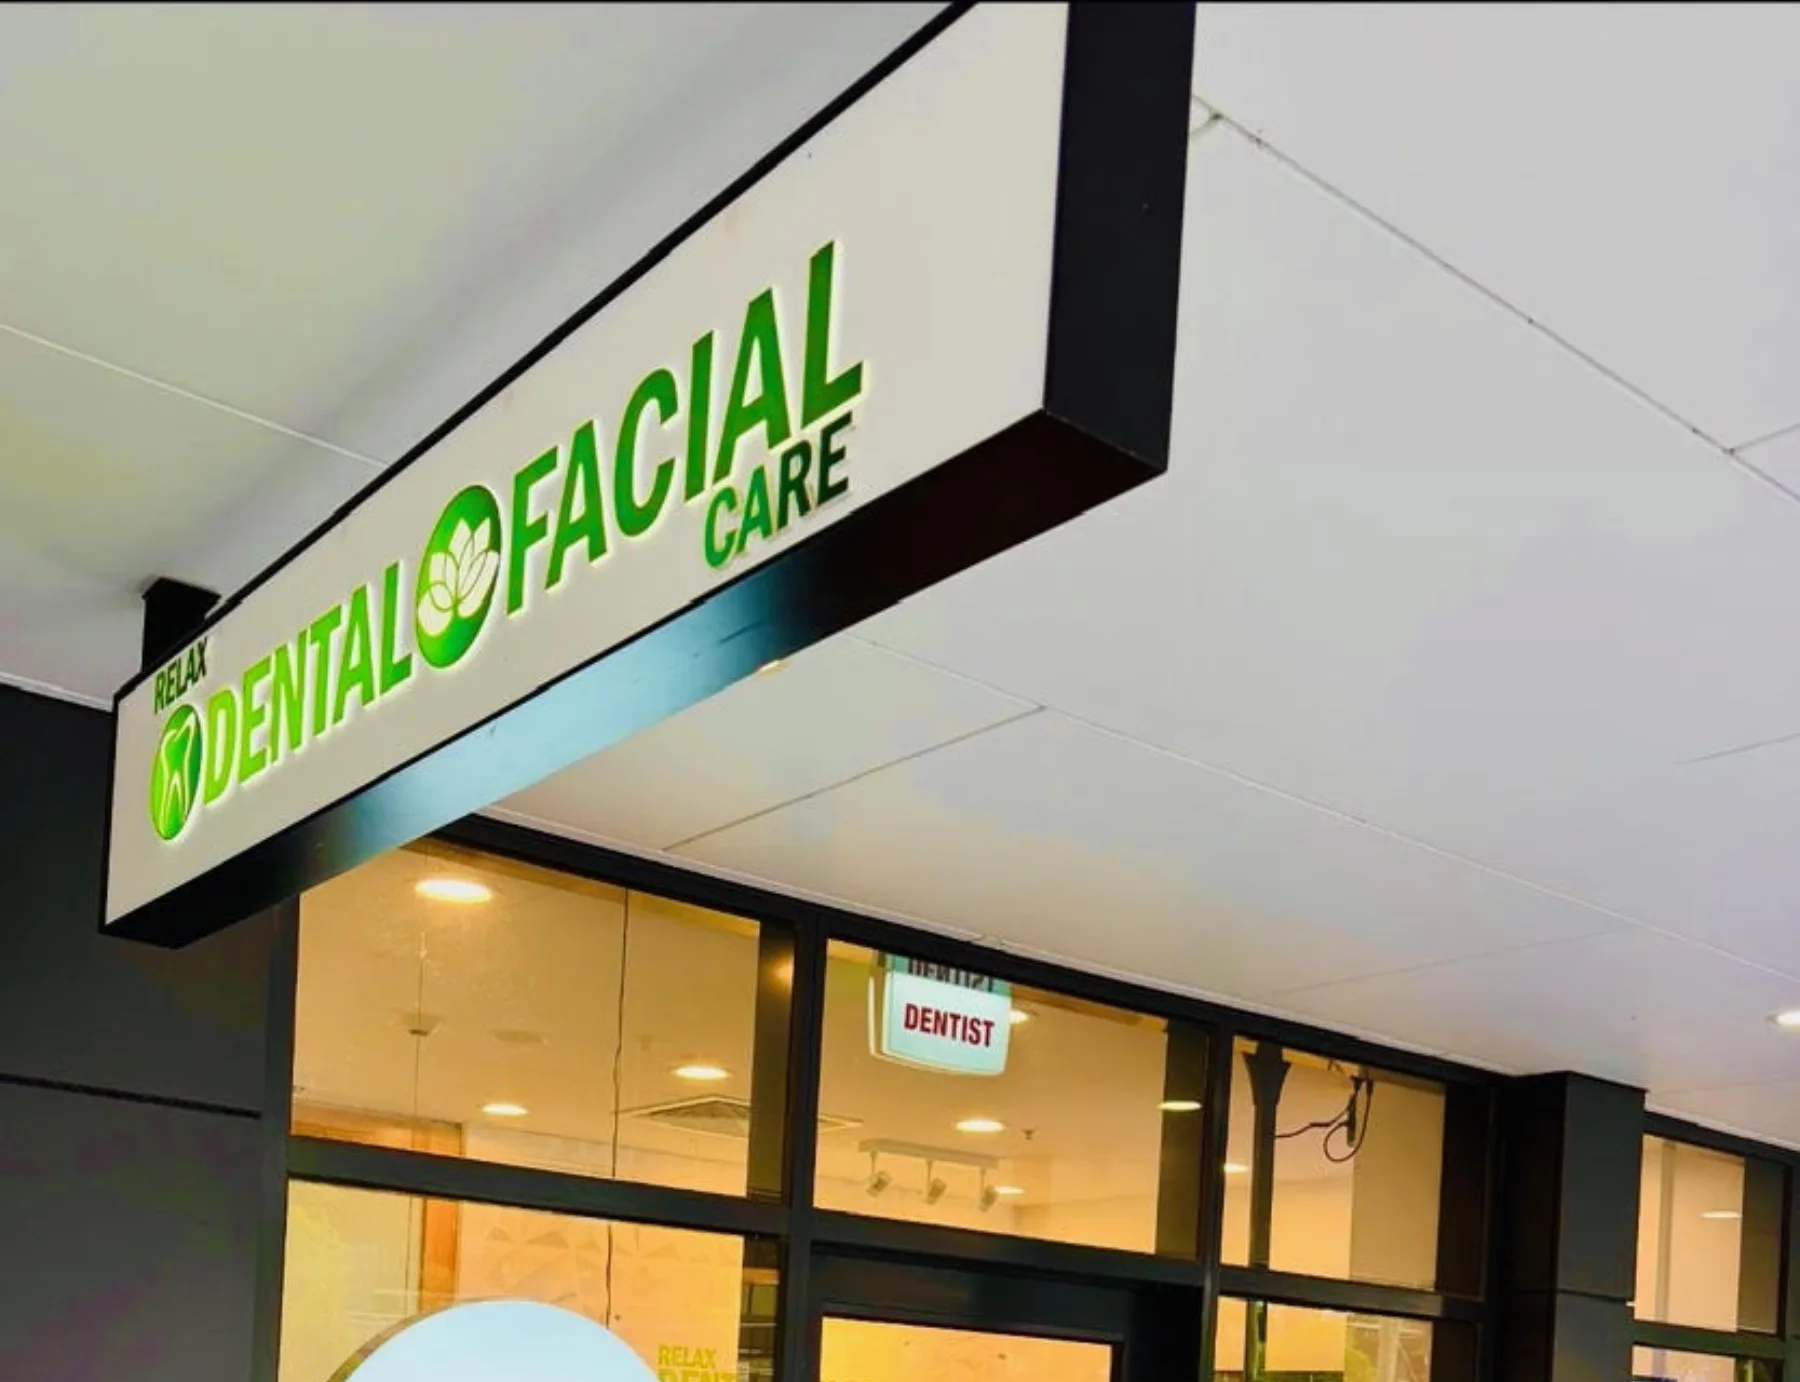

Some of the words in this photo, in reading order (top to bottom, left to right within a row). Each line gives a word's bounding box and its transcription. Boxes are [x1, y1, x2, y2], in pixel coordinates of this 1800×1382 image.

[203, 560, 412, 806] DENTAL
[506, 240, 863, 616] FACIAL
[704, 411, 852, 569] CARE
[155, 636, 208, 714] RELAX
[904, 1002, 994, 1048] DENTIST
[658, 1344, 717, 1369] RELAX
